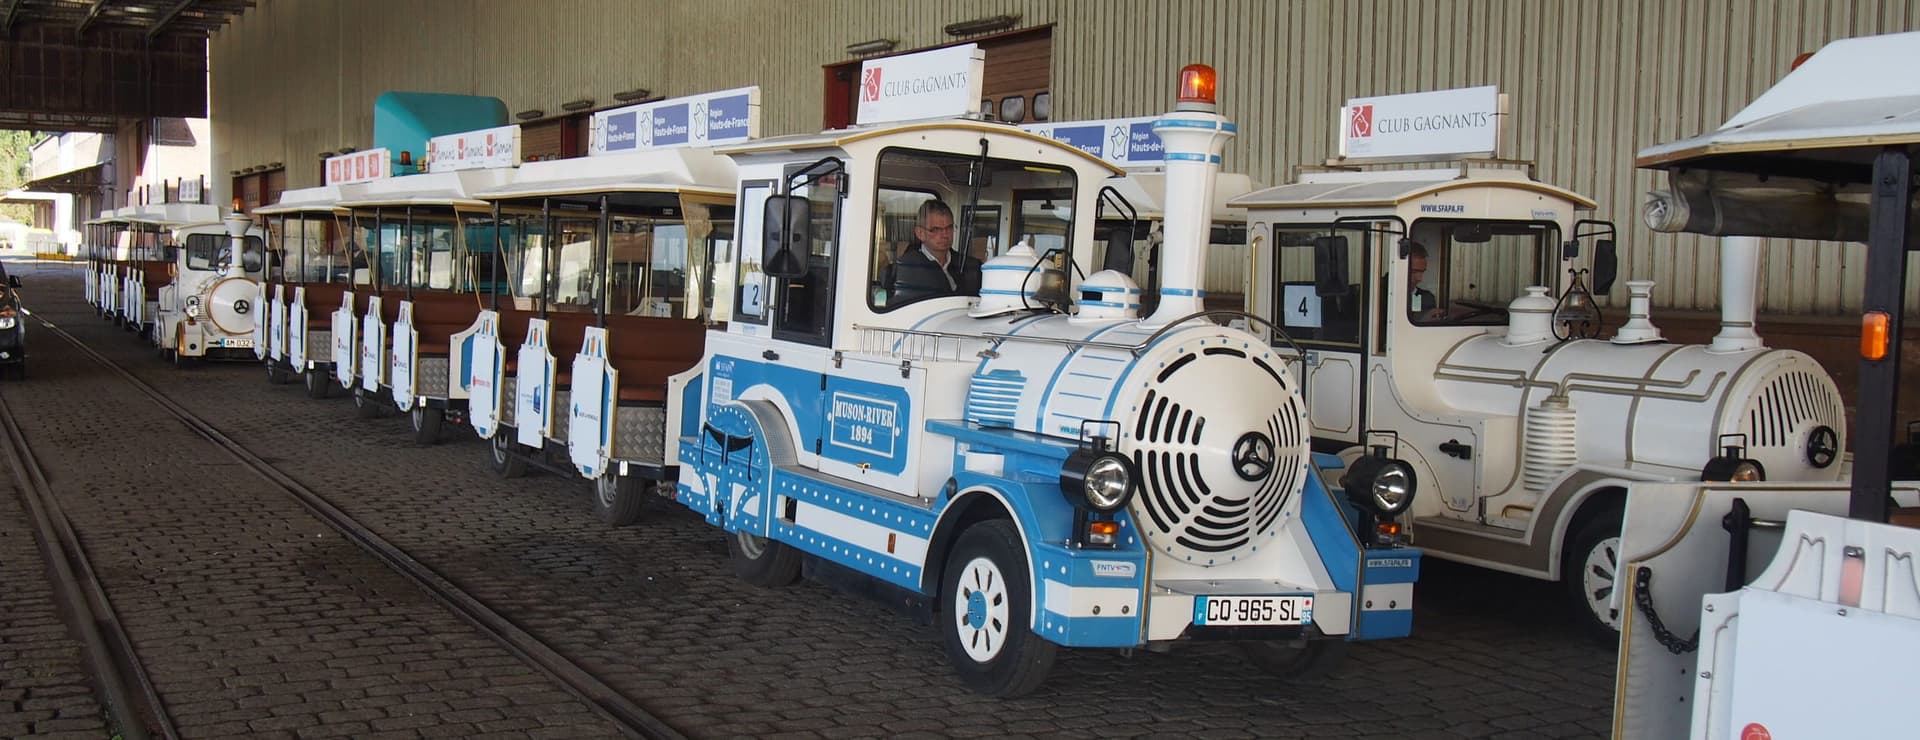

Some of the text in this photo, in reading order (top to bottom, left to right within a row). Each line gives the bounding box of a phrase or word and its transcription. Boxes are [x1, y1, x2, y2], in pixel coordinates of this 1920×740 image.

[884, 71, 967, 97] CLUB GAGNANTS
[1378, 111, 1487, 133] CLUB GAGNANTS
[1131, 131, 1149, 142] Région
[1131, 141, 1165, 153] Hauts-de-F
[752, 284, 759, 306] 2
[1298, 296, 1308, 317] 4
[850, 424, 873, 445] 1894
